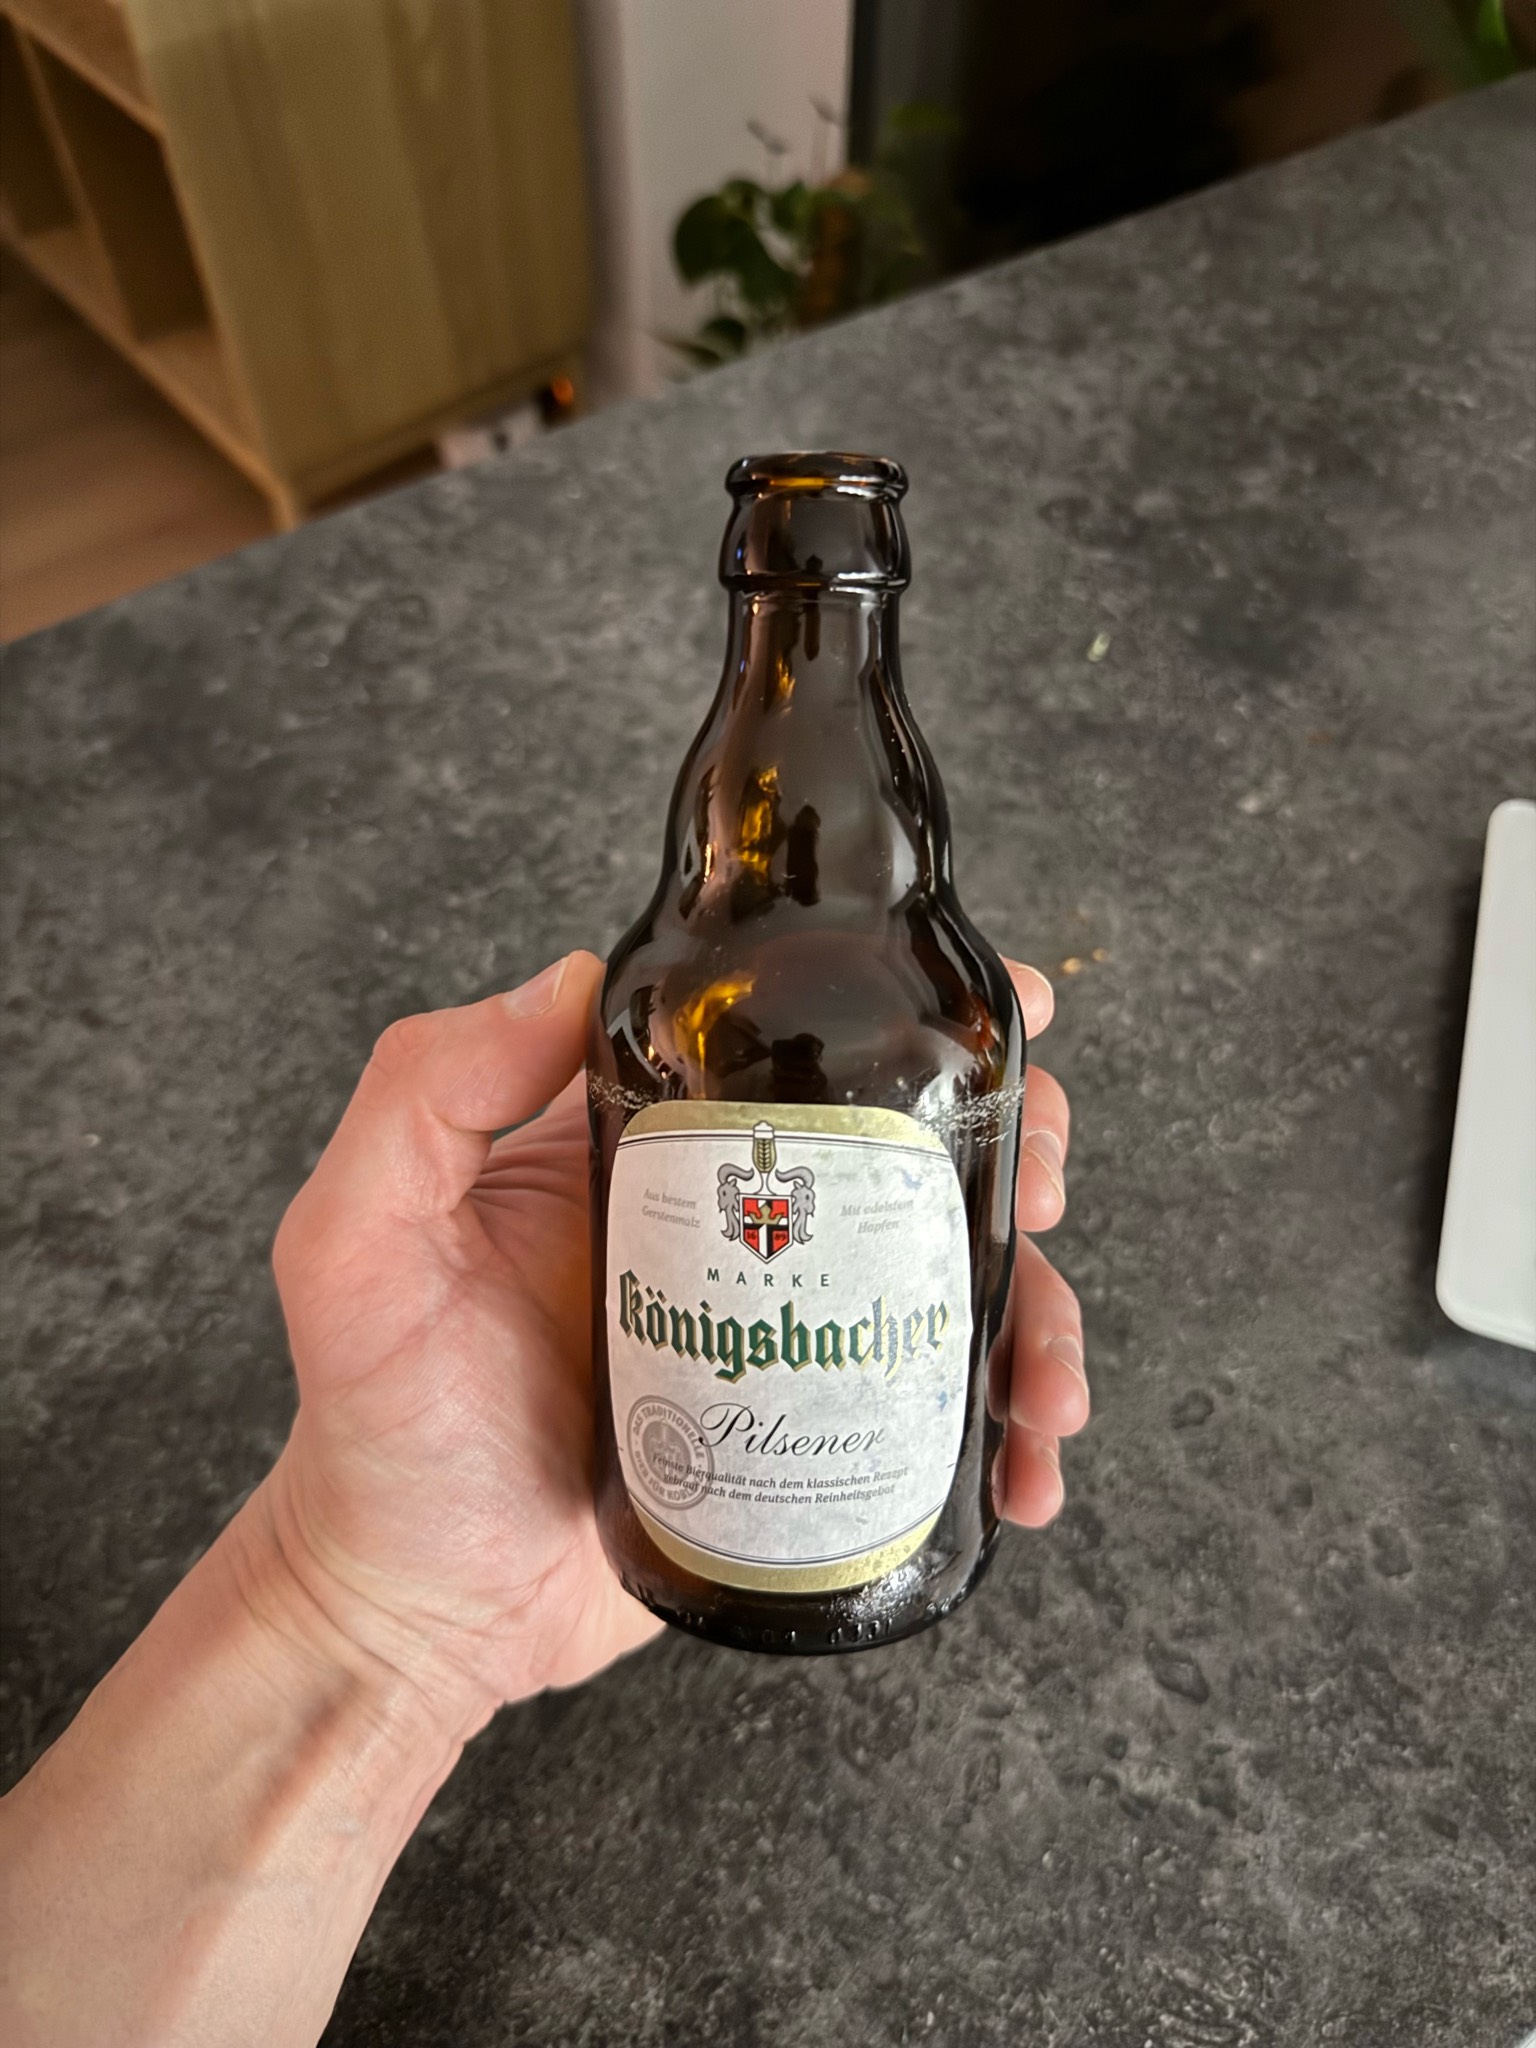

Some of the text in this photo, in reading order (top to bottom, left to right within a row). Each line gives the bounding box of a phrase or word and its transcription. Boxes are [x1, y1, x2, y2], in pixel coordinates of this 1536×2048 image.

[857, 1219, 899, 1235] Hopfen
[707, 1267, 830, 1288] MARKE
[618, 1269, 950, 1384] Königsbacher
[698, 1402, 886, 1457] Pilsener
[686, 1463, 746, 1486] Bierqualität
[749, 1477, 776, 1489] nach
[780, 1478, 804, 1489] dem
[806, 1474, 871, 1489] klassischen
[873, 1466, 908, 1481] Rezept
[700, 1485, 726, 1498] nach
[728, 1491, 752, 1502] dem
[754, 1492, 812, 1504] deutschen
[815, 1484, 896, 1503] Reinheitsgebot
